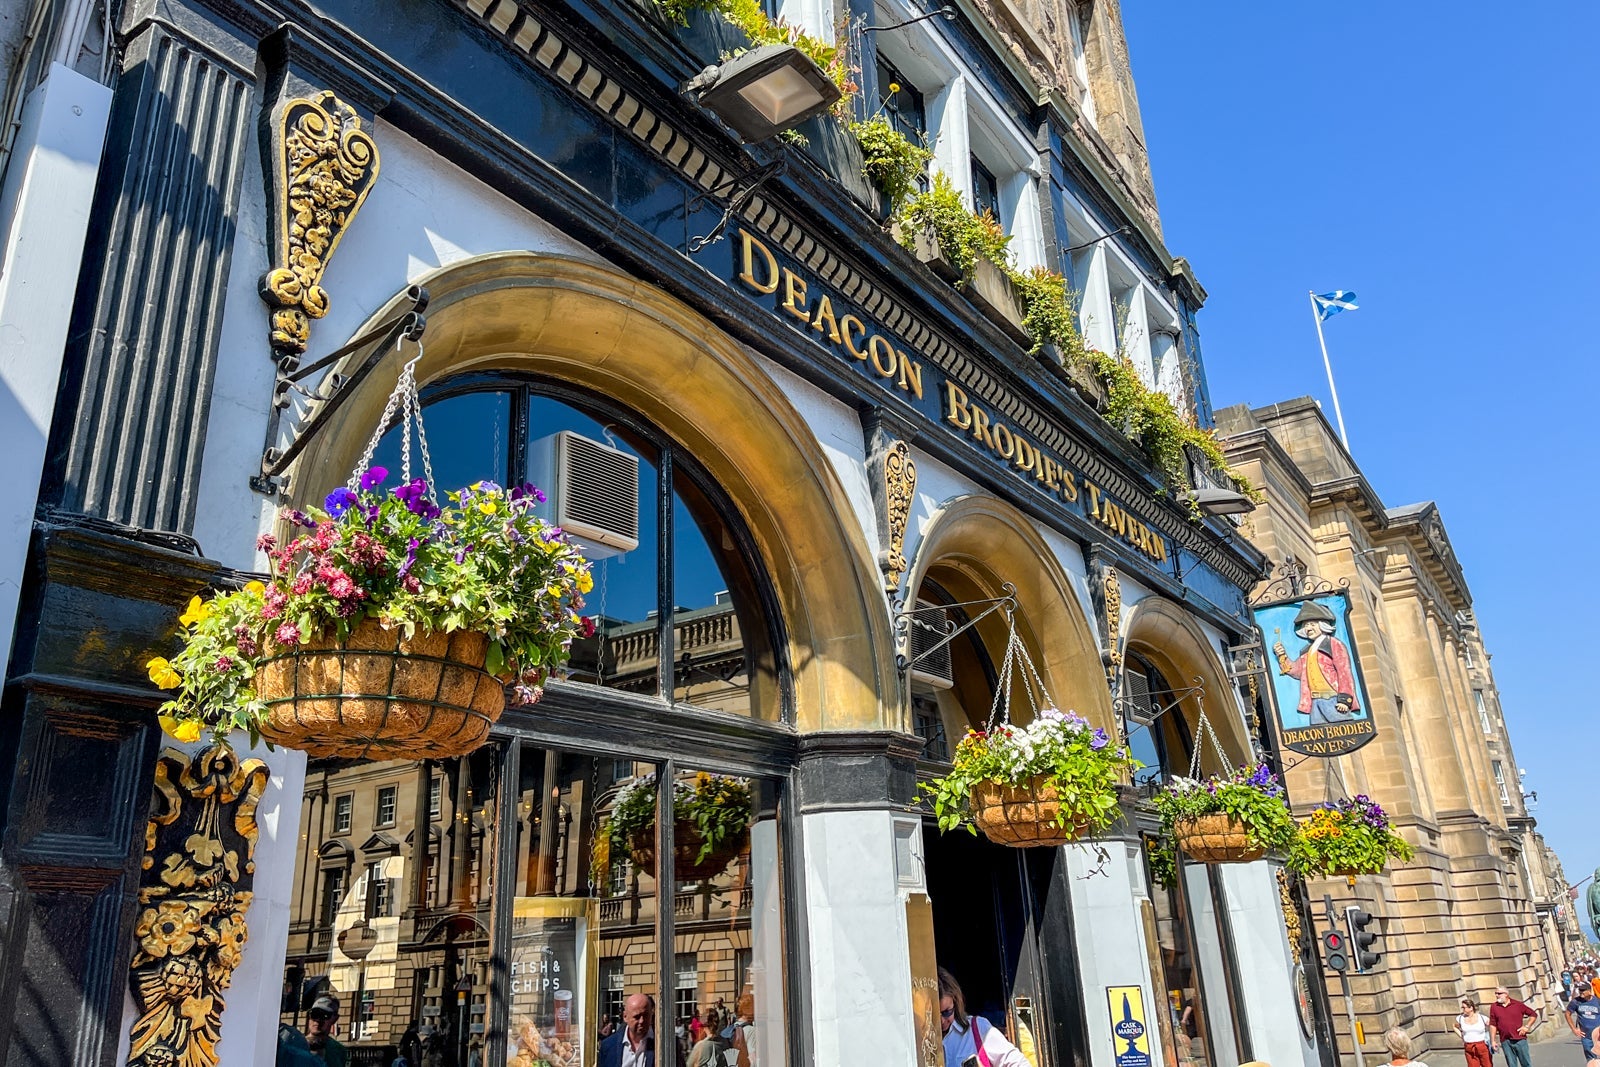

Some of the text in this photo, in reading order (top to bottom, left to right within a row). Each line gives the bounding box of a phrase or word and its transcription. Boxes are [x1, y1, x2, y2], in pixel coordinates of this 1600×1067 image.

[738, 227, 1167, 564] DEACON BRODIE'S TAVERN
[1283, 722, 1372, 745] DEACON BRODIE'S
[1304, 739, 1355, 753] TAVERN
[511, 960, 560, 974] FISH &
[511, 978, 560, 992] CHIPS
